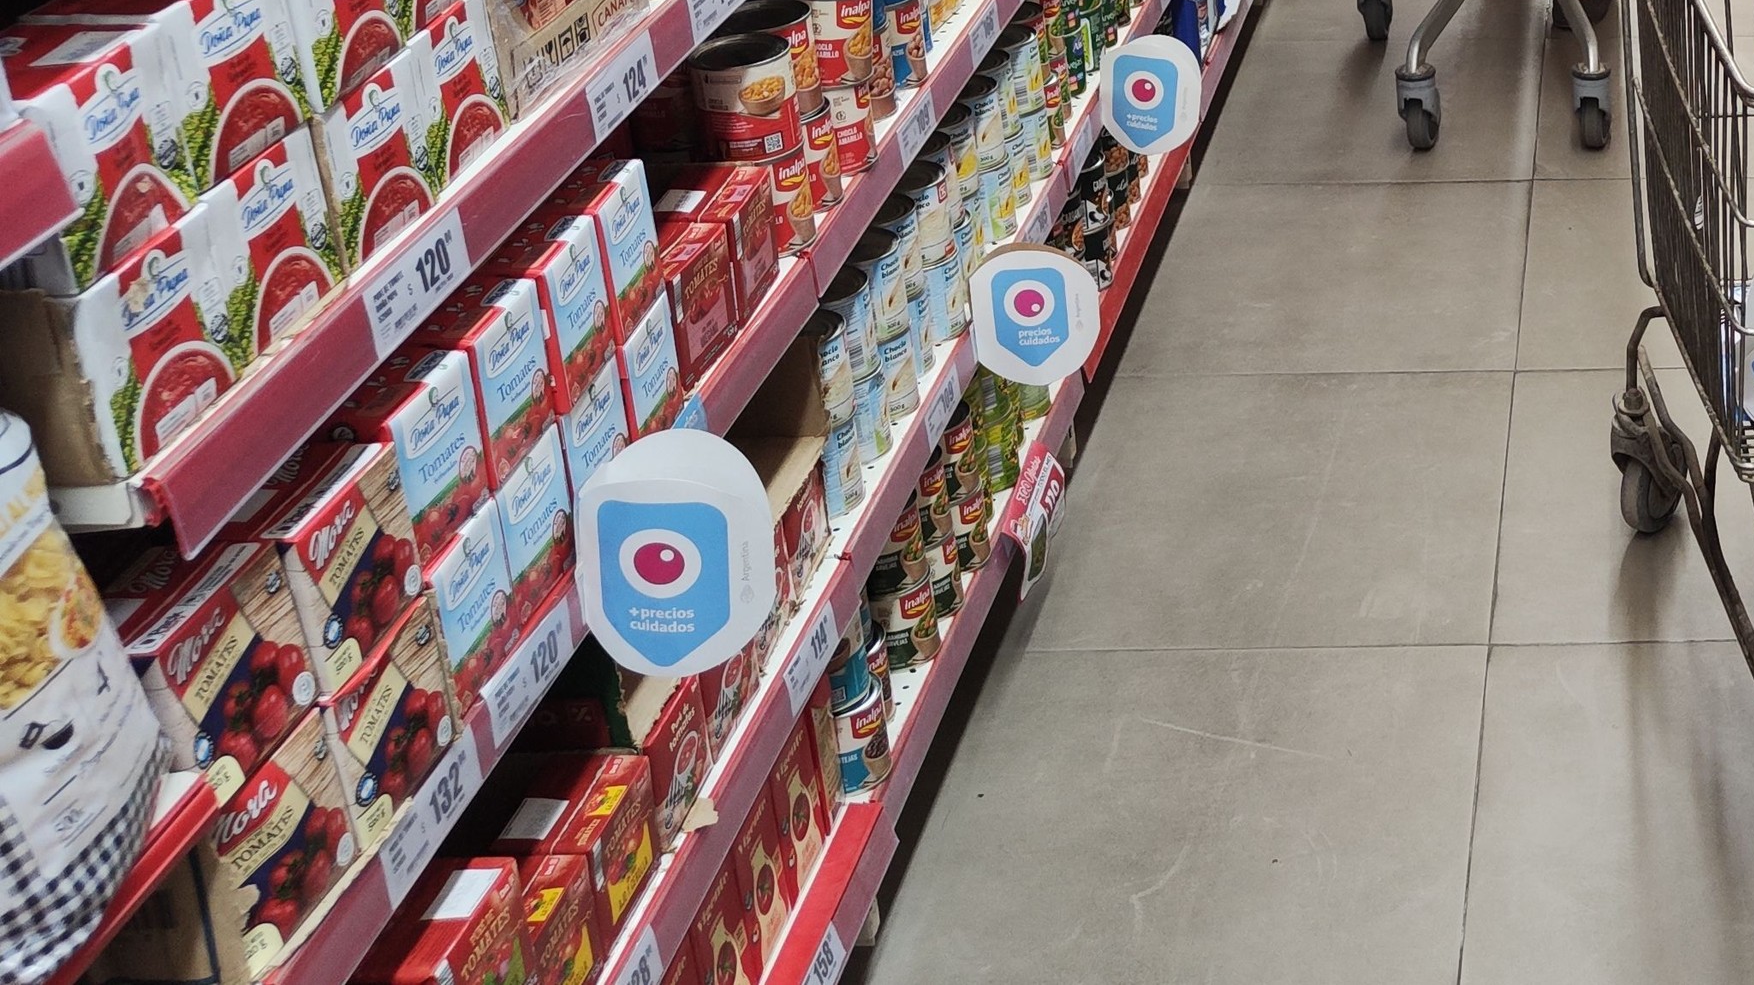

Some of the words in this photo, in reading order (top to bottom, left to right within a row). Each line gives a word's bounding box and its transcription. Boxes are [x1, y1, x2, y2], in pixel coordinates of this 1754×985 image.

[840, 0, 870, 18] inalpa
[622, 57, 647, 103] 124
[1126, 119, 1158, 132] cuidados
[414, 238, 450, 294] 120
[619, 228, 647, 267] Tomates
[566, 288, 597, 330] Tomates
[1018, 327, 1052, 337] precios
[1019, 335, 1061, 346] cuidados
[496, 358, 536, 403] Tomates
[642, 357, 669, 397] Tomates
[418, 432, 466, 483] Tomates
[520, 498, 558, 546] Tomates
[329, 527, 365, 586] TOMATES
[457, 578, 497, 632] Tomates
[630, 619, 695, 633] cuidados
[195, 634, 237, 702] TOMATES
[530, 637, 559, 685] 120
[359, 683, 393, 745] TOMATES
[429, 769, 464, 826] 132
[231, 804, 294, 872] TOMATES
